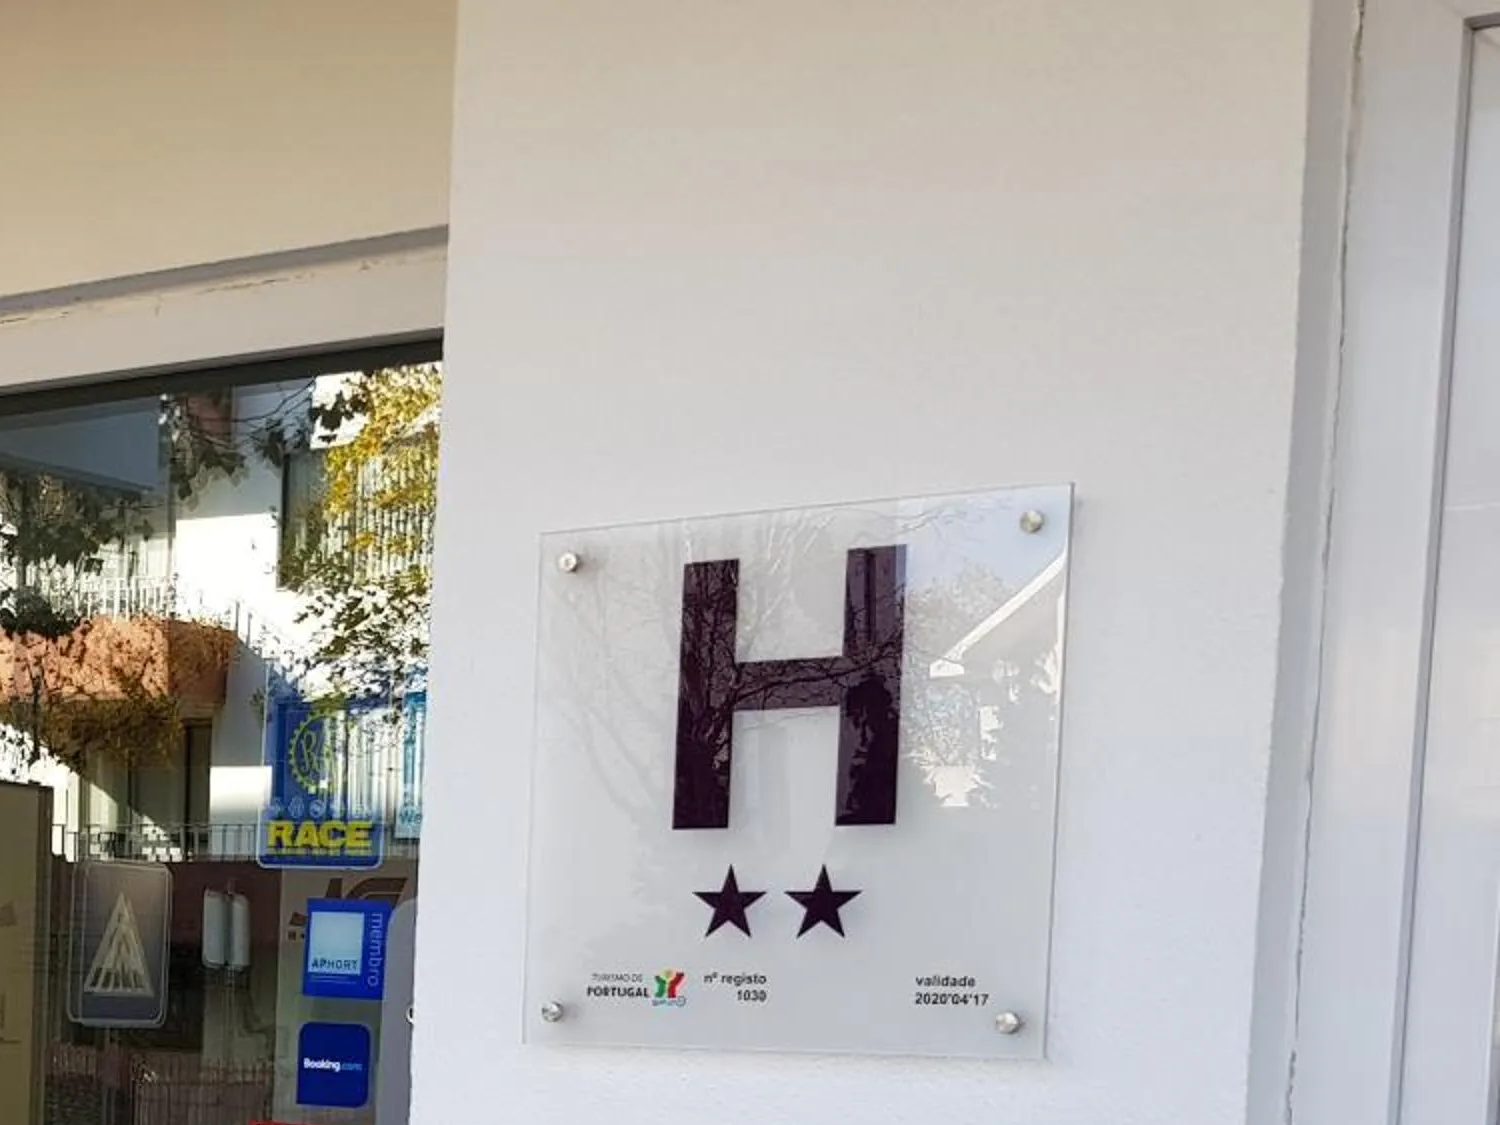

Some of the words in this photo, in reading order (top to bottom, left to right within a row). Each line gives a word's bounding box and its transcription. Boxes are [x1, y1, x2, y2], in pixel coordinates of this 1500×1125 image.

[672, 543, 907, 831] H
[266, 819, 373, 848] RACE
[367, 912, 384, 987] membro
[310, 958, 359, 971] APHORT
[721, 972, 767, 987] registo
[915, 975, 976, 988] validade
[586, 985, 650, 998] PORTUGAL
